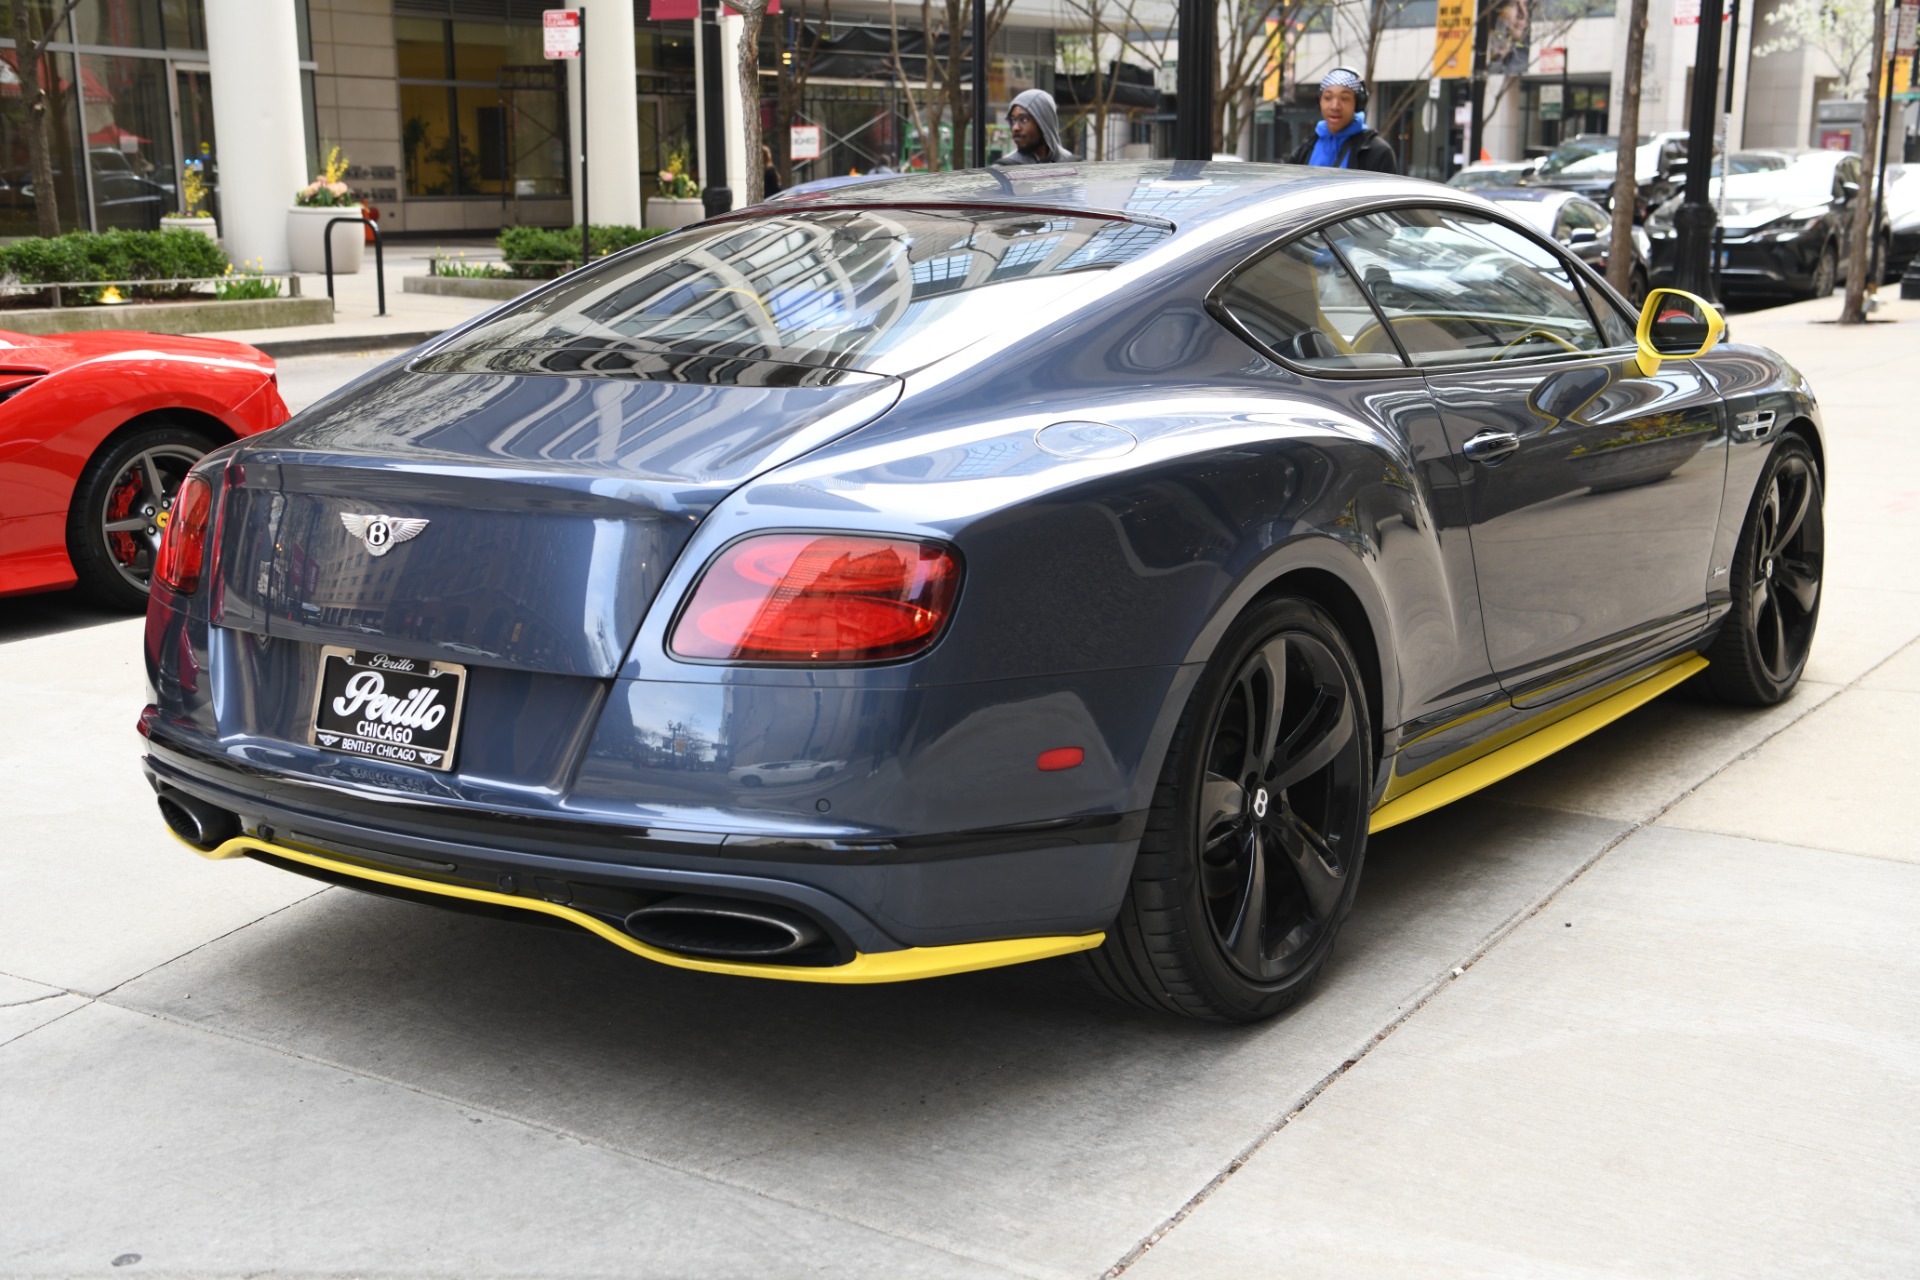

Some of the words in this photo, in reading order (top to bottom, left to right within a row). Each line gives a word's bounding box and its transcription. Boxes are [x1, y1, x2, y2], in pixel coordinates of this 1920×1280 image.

[368, 653, 415, 671] Perillo
[332, 670, 446, 731] Perillo
[356, 720, 413, 744] CHICAGO
[341, 738, 376, 753] BENTLEY
[376, 744, 416, 761] CHICAGO
